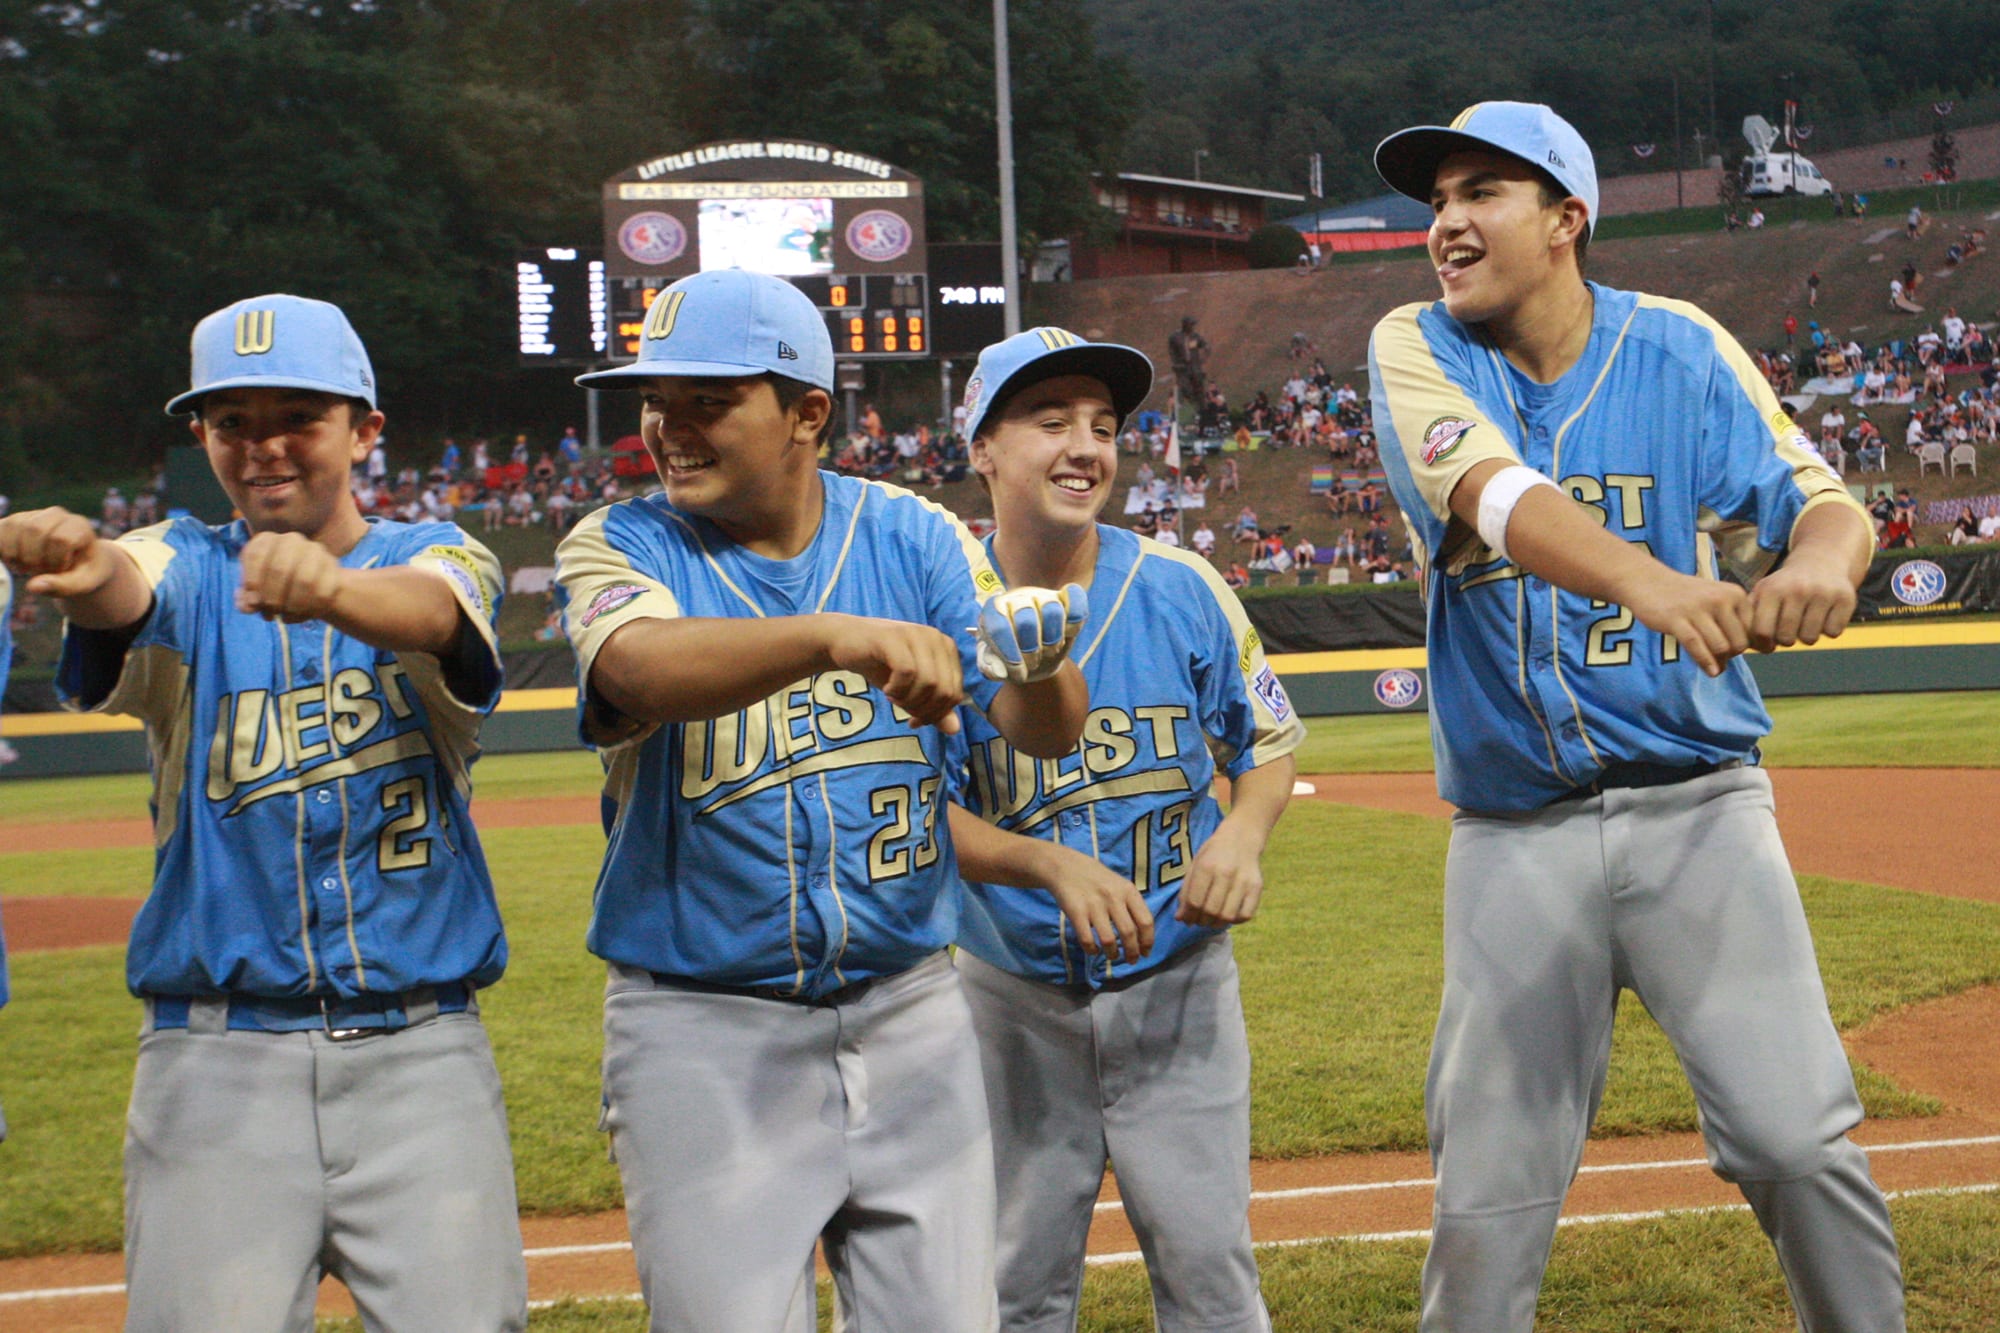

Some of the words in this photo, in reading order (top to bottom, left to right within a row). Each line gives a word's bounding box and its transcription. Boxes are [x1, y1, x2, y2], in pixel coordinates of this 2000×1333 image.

[625, 186, 724, 197] EASTON
[734, 184, 900, 197] FOUNDATIONS
[638, 151, 696, 180] LITTLE
[696, 142, 764, 164] LEAGUE
[766, 143, 829, 162] WORLD
[832, 151, 891, 179] SERIES
[234, 309, 276, 356] W
[681, 670, 911, 800] WES
[867, 776, 943, 883] 23
[1131, 800, 1194, 892] 13
